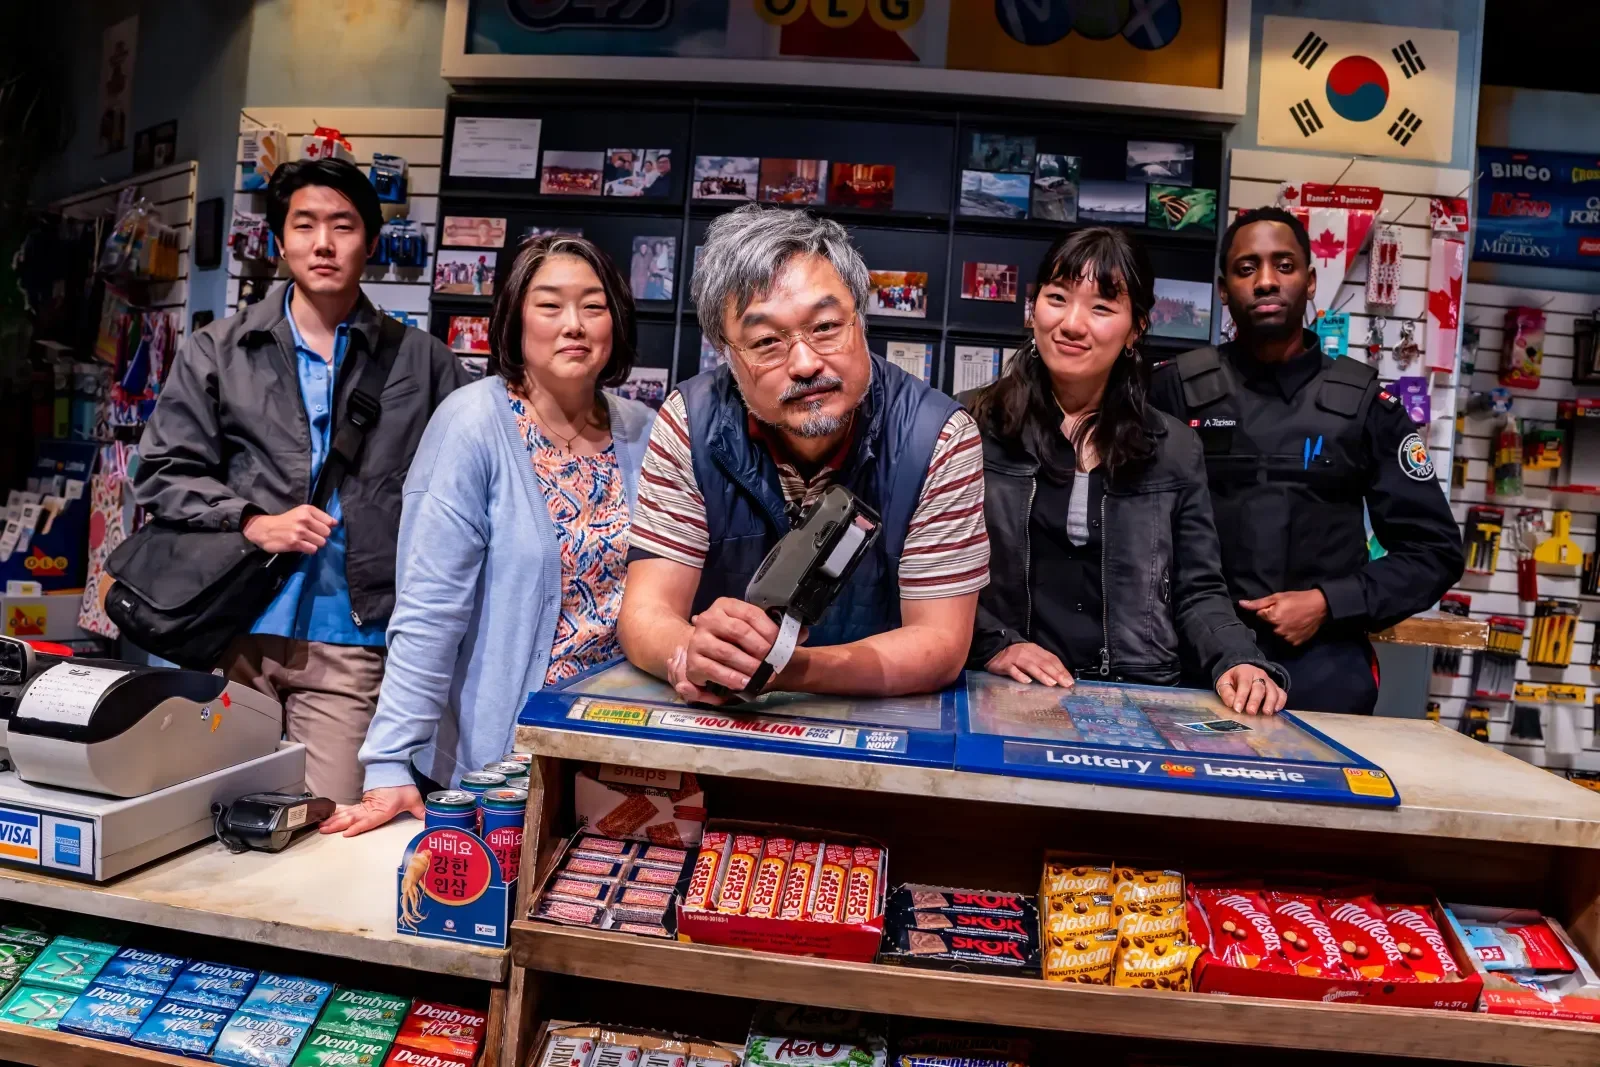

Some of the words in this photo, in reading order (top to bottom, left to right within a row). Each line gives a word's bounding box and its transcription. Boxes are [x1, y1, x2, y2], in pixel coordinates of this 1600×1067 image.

[1490, 162, 1551, 181] BINGO
[1481, 239, 1551, 258] MILLIONS
[1204, 419, 1212, 427] A
[594, 709, 640, 719] JUMBO
[695, 716, 728, 728] $100
[730, 720, 806, 736] MILLION
[866, 741, 896, 749] NOW!
[614, 765, 667, 781] snaps
[1046, 750, 1152, 774] Lottery
[1203, 763, 1305, 783] Loterie
[0, 824, 32, 845] VISA
[55, 837, 79, 847] AMERICAN
[428, 836, 473, 855] 비비요
[434, 855, 468, 877] 강한
[434, 877, 467, 897] 인삼
[695, 863, 711, 896] CRISP
[723, 859, 741, 900] COFFEE
[732, 866, 748, 901] CRISP
[753, 863, 771, 905] COFFEE
[762, 871, 778, 906] CRISP
[791, 875, 805, 909] CRISP
[816, 870, 833, 912] COFFEE
[825, 878, 840, 913] CRISP
[848, 872, 862, 915] COFFEE
[857, 881, 870, 917] CRISP
[953, 893, 1023, 911] SKOR
[957, 915, 1028, 936] SKOR
[1216, 894, 1281, 951] Maltesers
[1330, 903, 1403, 962] Maltesers
[1275, 901, 1342, 966] Maltesers
[1386, 909, 1459, 973] Maltesers
[119, 948, 184, 968] Dentyne
[952, 936, 1025, 960] SKOR
[123, 962, 158, 976] ice
[188, 962, 255, 981] Dentyne
[194, 976, 229, 990] ice
[261, 974, 328, 994] Dentyne
[85, 987, 153, 1008] Dentyne
[269, 989, 302, 1004] ice
[336, 991, 406, 1011] Dentyne
[1488, 994, 1502, 1003] 12
[90, 1002, 126, 1017] ice
[157, 1002, 227, 1025] Dentyne
[345, 1007, 380, 1022] ice
[413, 1004, 485, 1026] Dentyne
[164, 1015, 201, 1032] ice
[232, 1016, 302, 1037] Dentyne
[421, 1020, 461, 1037] fire
[240, 1032, 276, 1049] ice
[310, 1034, 383, 1055] Dentyne
[320, 1050, 357, 1067] ice
[393, 1050, 466, 1067] Dentyne
